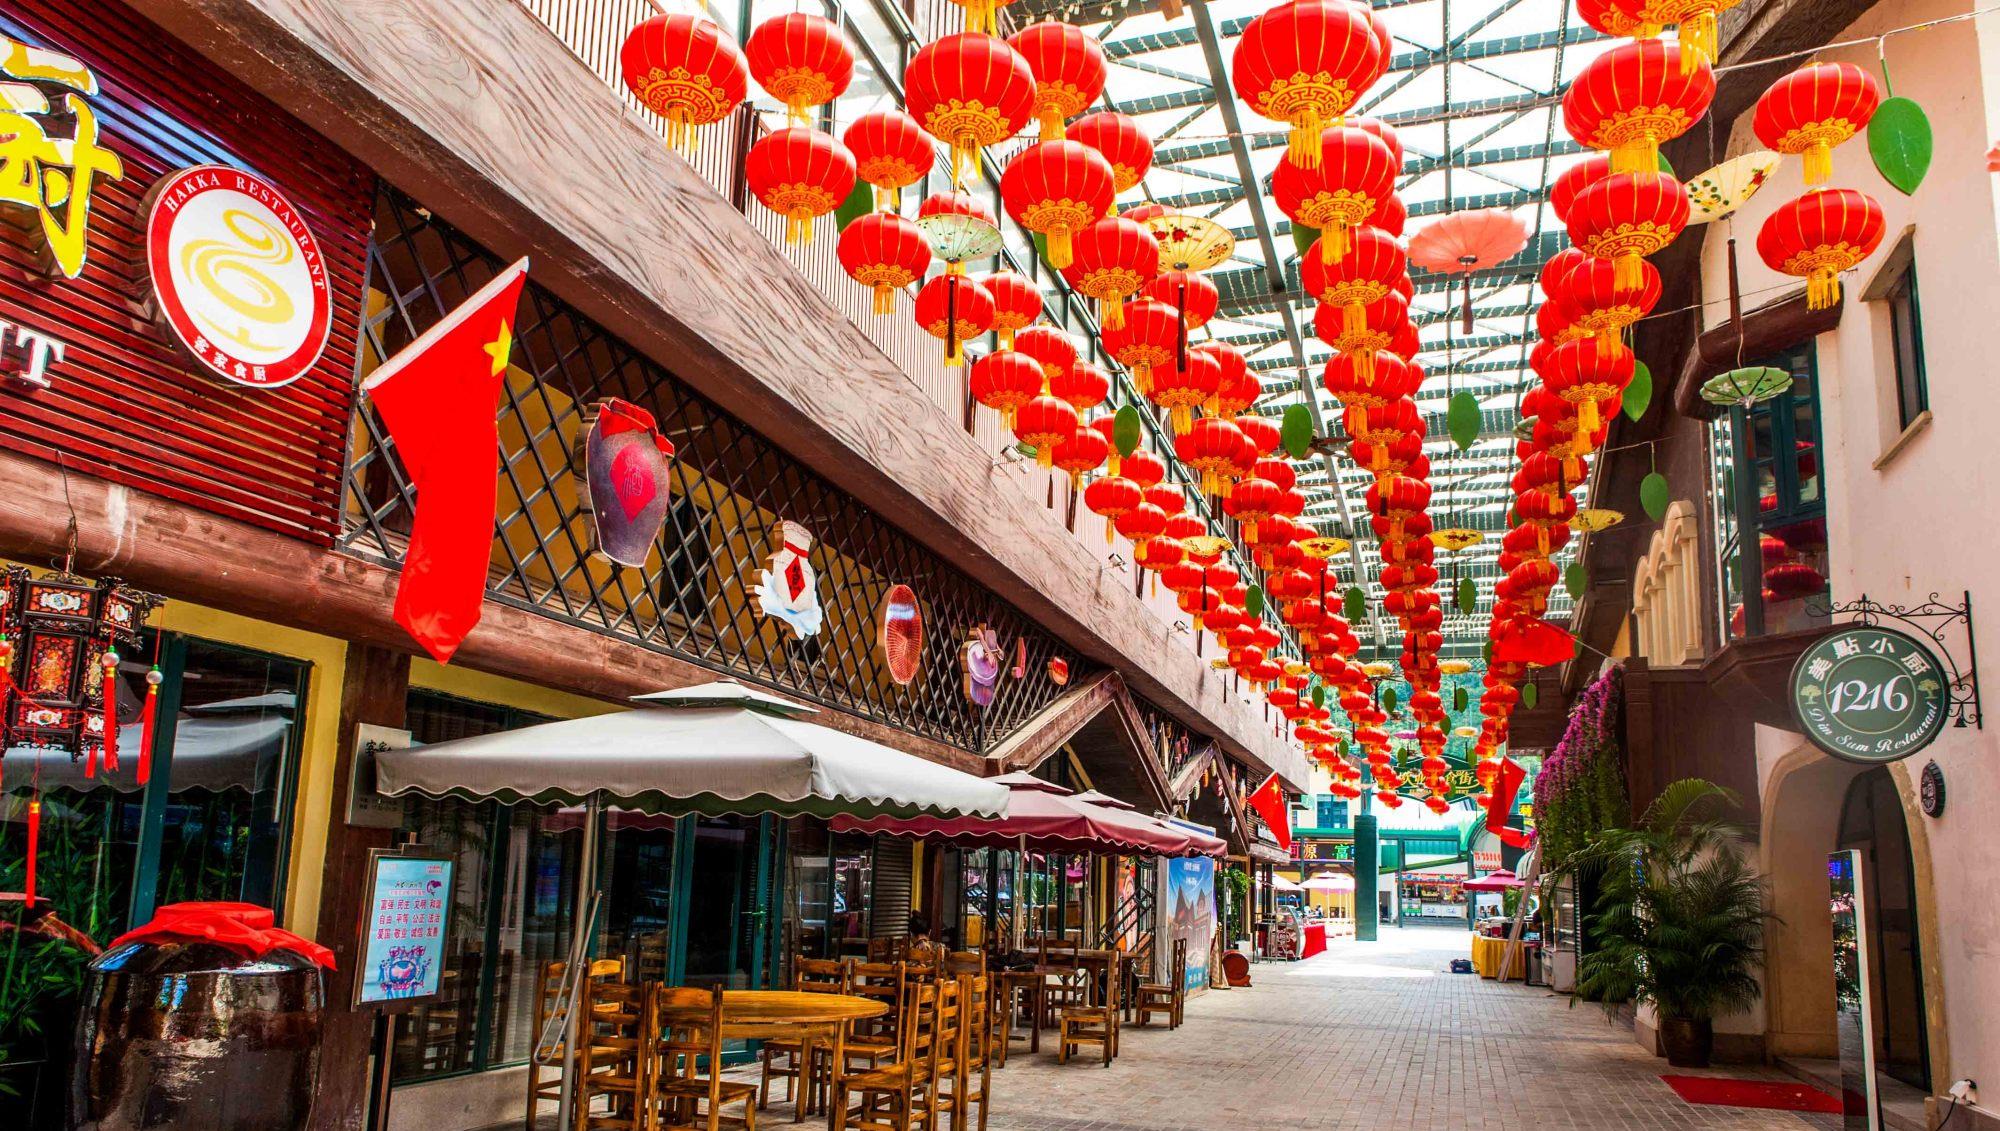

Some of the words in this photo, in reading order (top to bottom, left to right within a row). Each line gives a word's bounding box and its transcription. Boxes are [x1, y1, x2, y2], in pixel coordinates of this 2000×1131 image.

[164, 172, 222, 213] HAKKA
[236, 175, 326, 290] RESTAURANT
[1827, 674, 1910, 714] 1216
[1807, 707, 1833, 736] Dim
[1835, 734, 1870, 752] Sum
[1874, 701, 1938, 753] Restaurant
